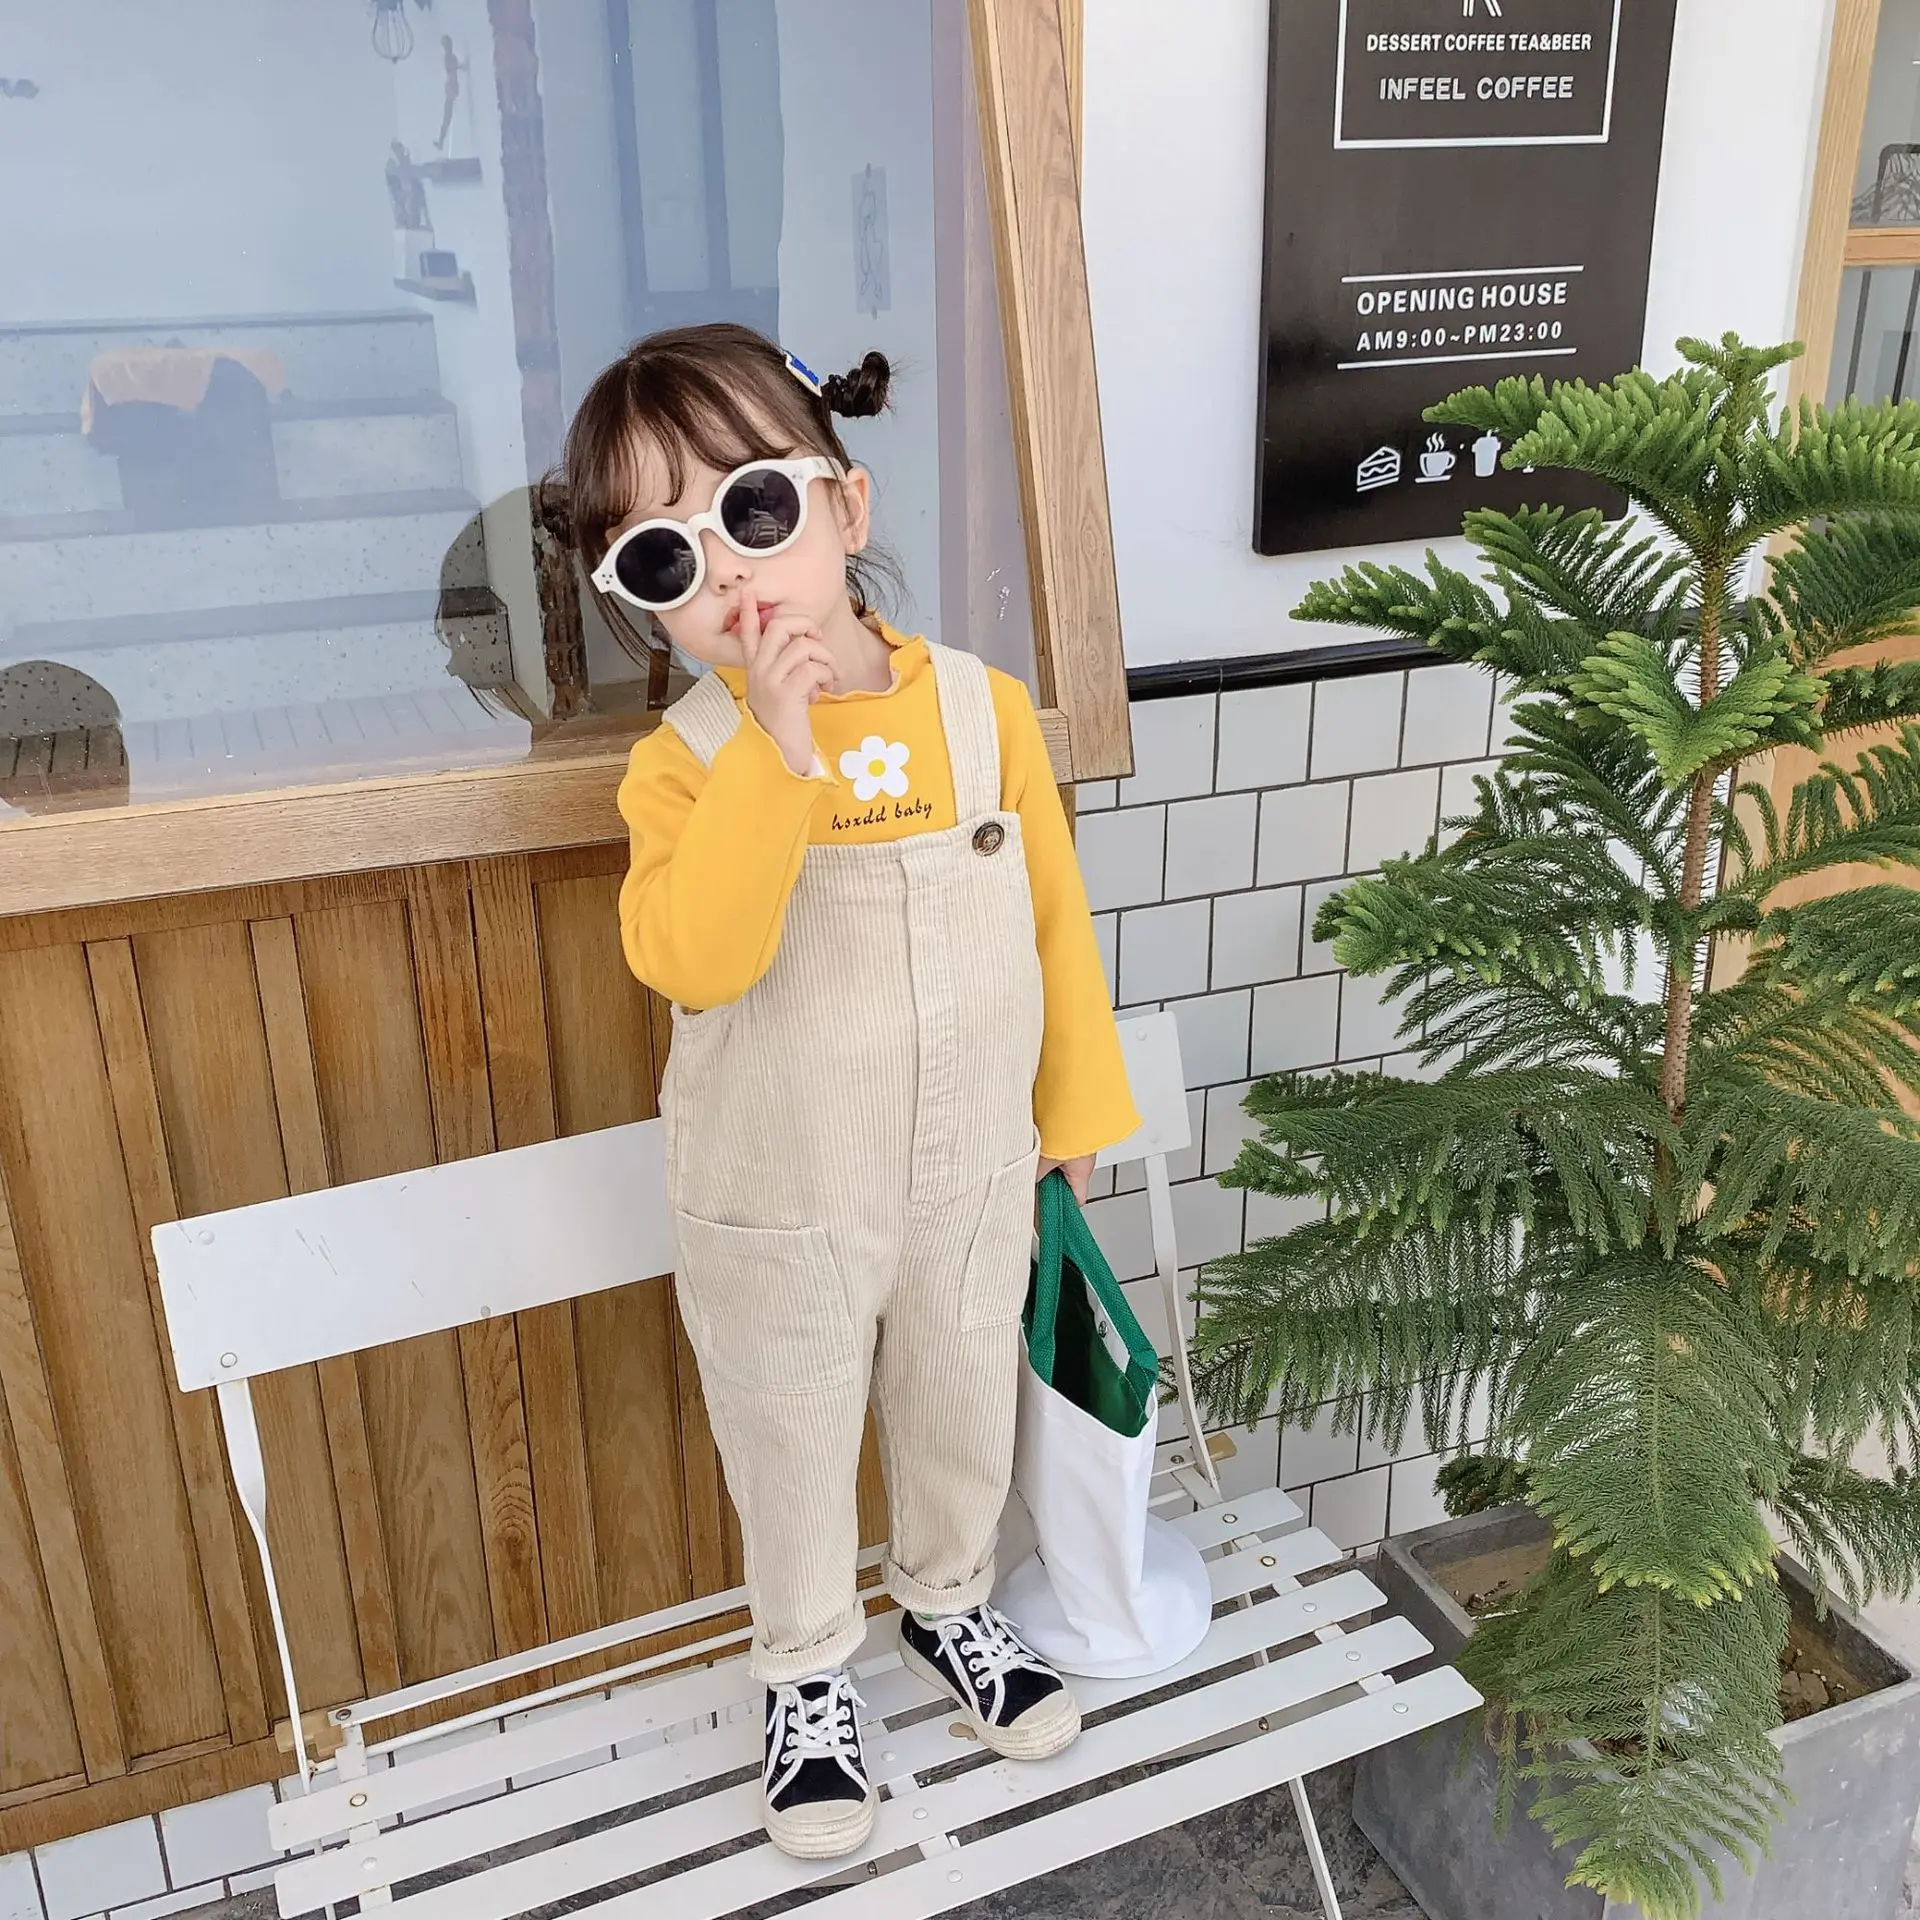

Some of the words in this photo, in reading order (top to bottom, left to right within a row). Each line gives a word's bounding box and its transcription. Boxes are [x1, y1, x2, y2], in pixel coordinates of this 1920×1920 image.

[1366, 33, 1442, 52] DESSERT
[1444, 33, 1506, 52] COFFEE
[1508, 33, 1592, 51] TEA&BEER
[1379, 77, 1466, 101] INFEEL
[1476, 75, 1574, 100] COFFEE
[1356, 286, 1475, 316] OPENING
[1481, 281, 1568, 309] HOUSE
[831, 805, 887, 831] hsxdd
[894, 797, 933, 820] baby
